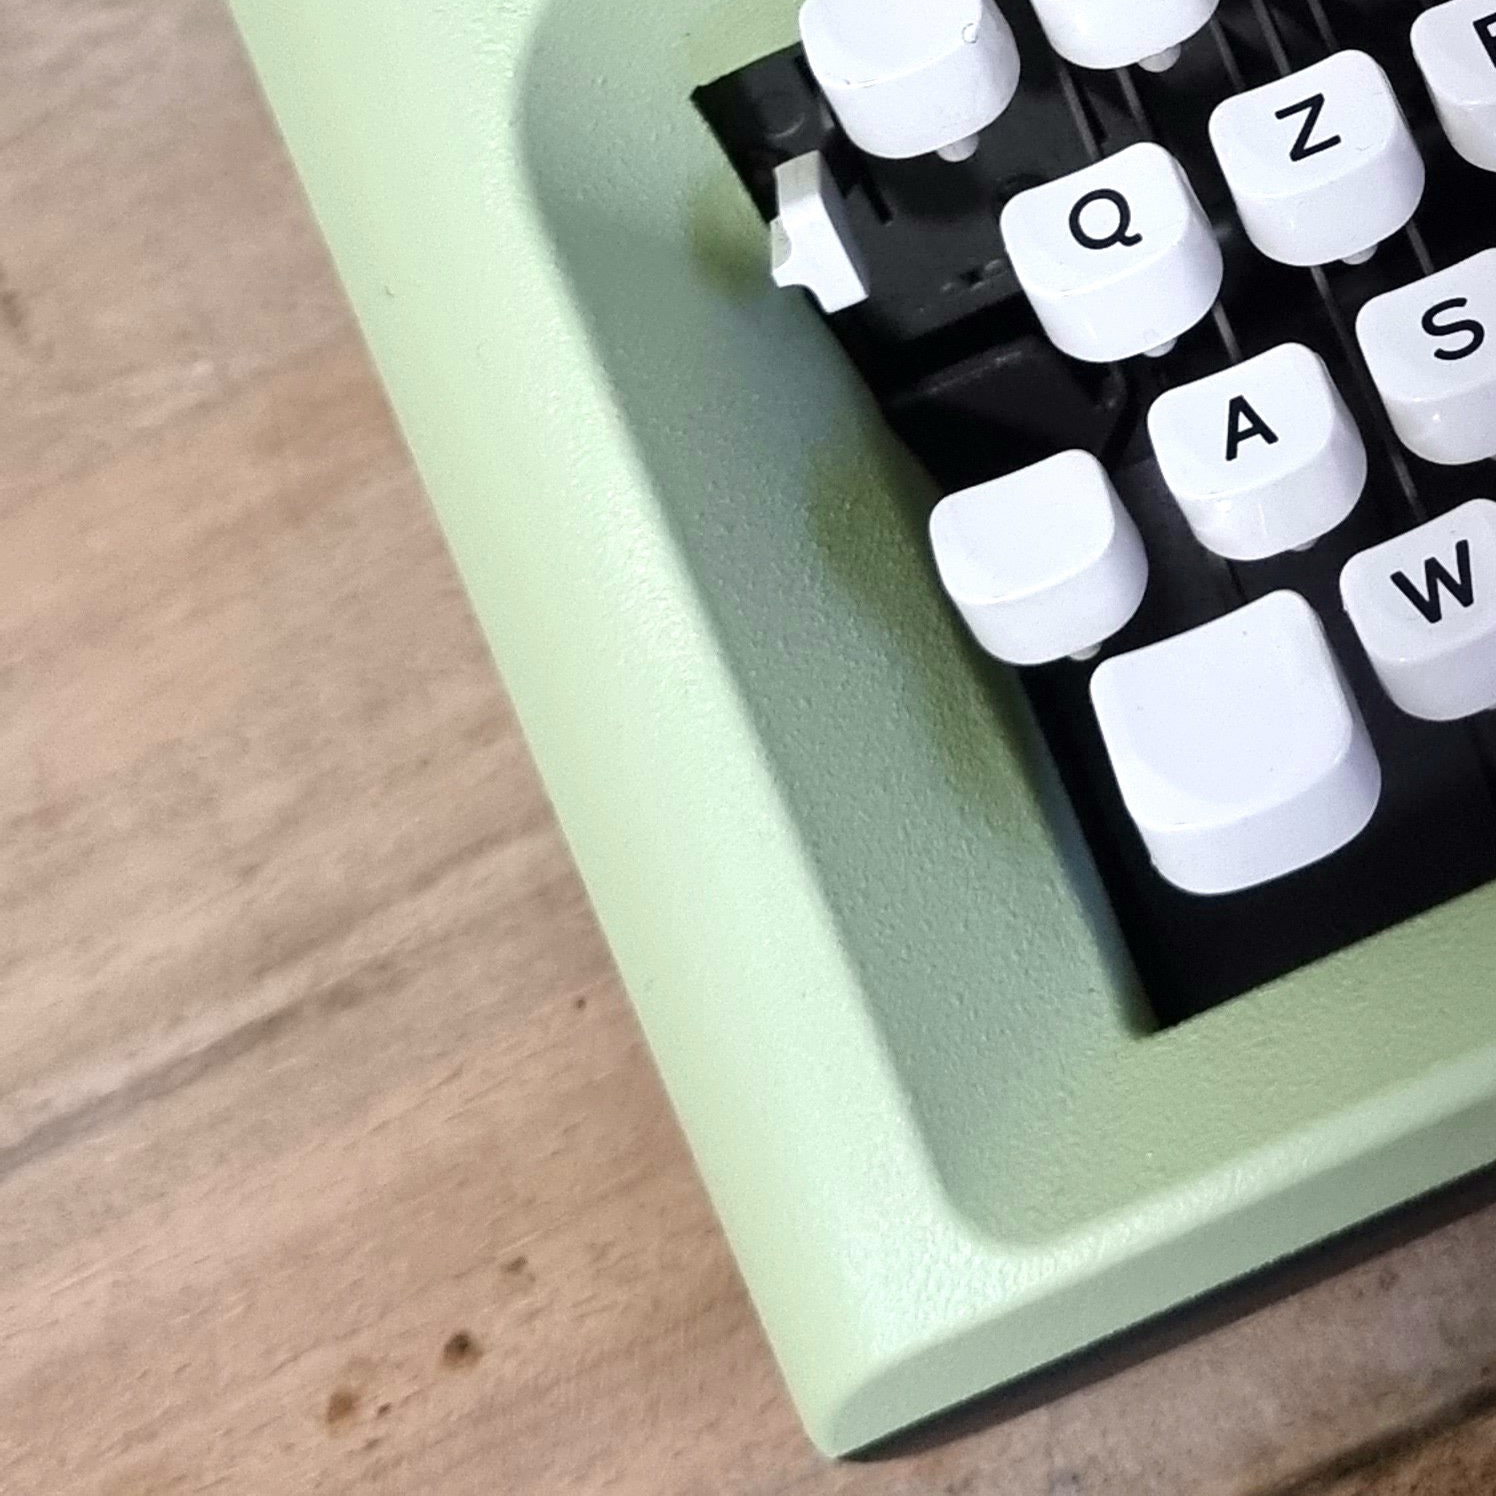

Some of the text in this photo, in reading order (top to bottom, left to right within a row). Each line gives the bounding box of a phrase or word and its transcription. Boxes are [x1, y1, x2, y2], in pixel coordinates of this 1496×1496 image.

[1275, 93, 1341, 161] Z
[1069, 189, 1142, 249] Q
[1422, 298, 1484, 360] S
[1226, 396, 1278, 461] A
[1390, 540, 1474, 623] W
